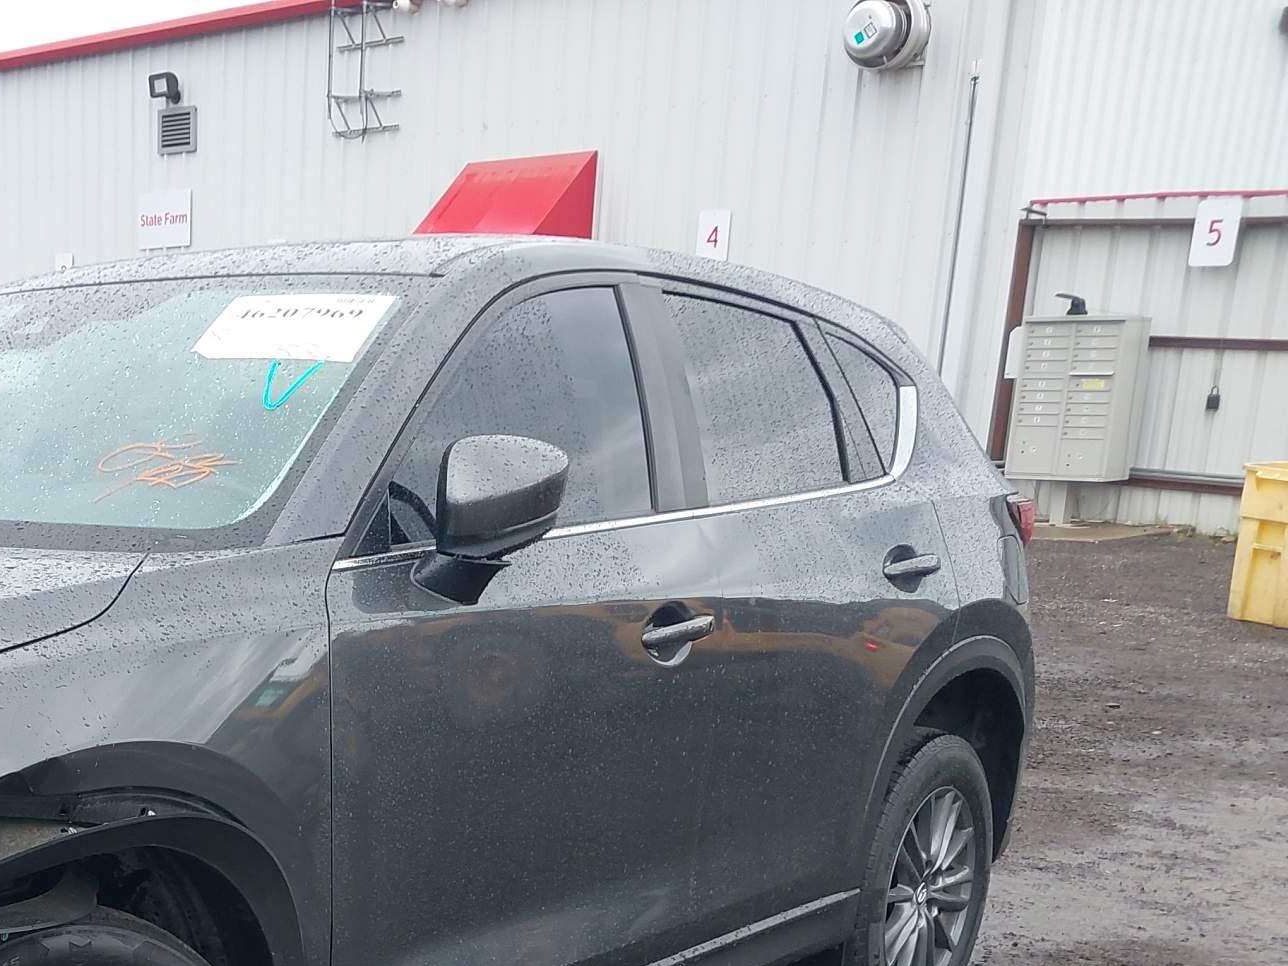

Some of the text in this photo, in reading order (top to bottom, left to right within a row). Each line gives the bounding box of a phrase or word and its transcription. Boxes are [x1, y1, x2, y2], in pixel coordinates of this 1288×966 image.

[140, 211, 188, 227] State Farm
[706, 225, 719, 249] 4
[1206, 219, 1224, 247] 5
